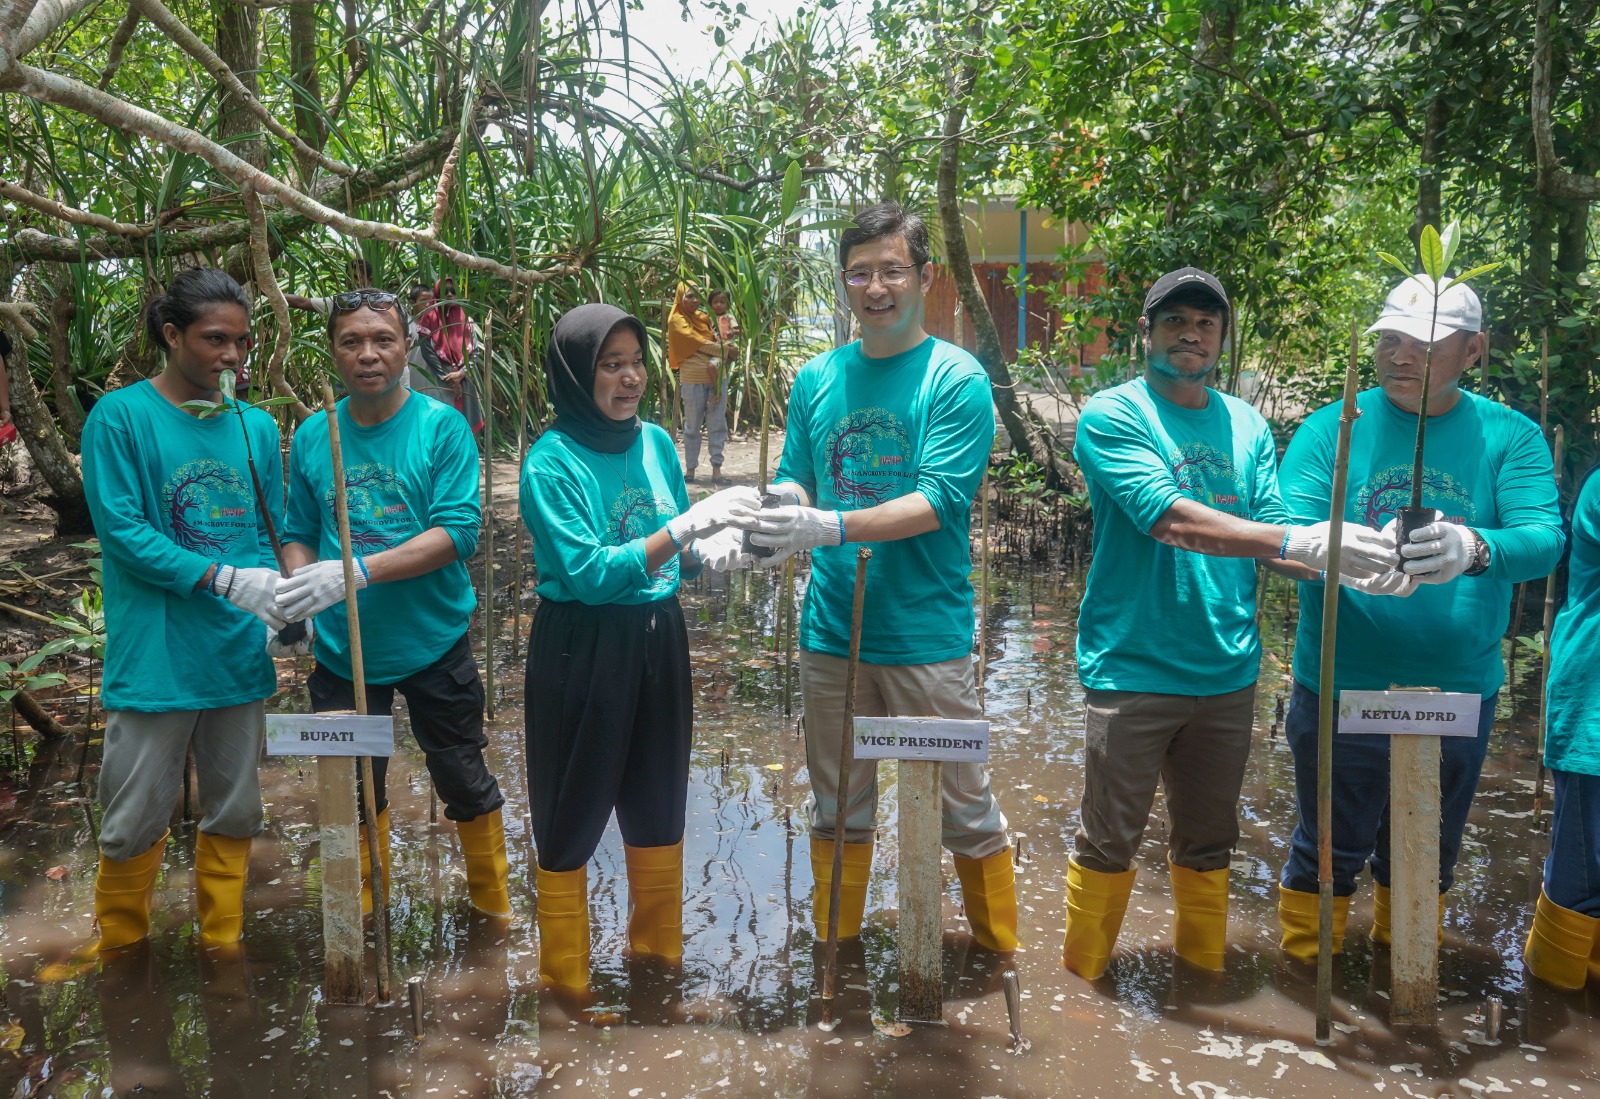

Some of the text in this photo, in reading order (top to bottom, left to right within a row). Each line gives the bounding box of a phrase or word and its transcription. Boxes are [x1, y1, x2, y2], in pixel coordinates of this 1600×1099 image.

[880, 455, 902, 466] IWIP
[1214, 494, 1239, 505] IWIP
[221, 507, 247, 517] IWIP
[384, 503, 408, 515] IWIP
[1361, 710, 1457, 722] KETUA DPRD
[300, 731, 355, 742] BUPATI
[860, 735, 983, 750] VICE PRESIDENT
